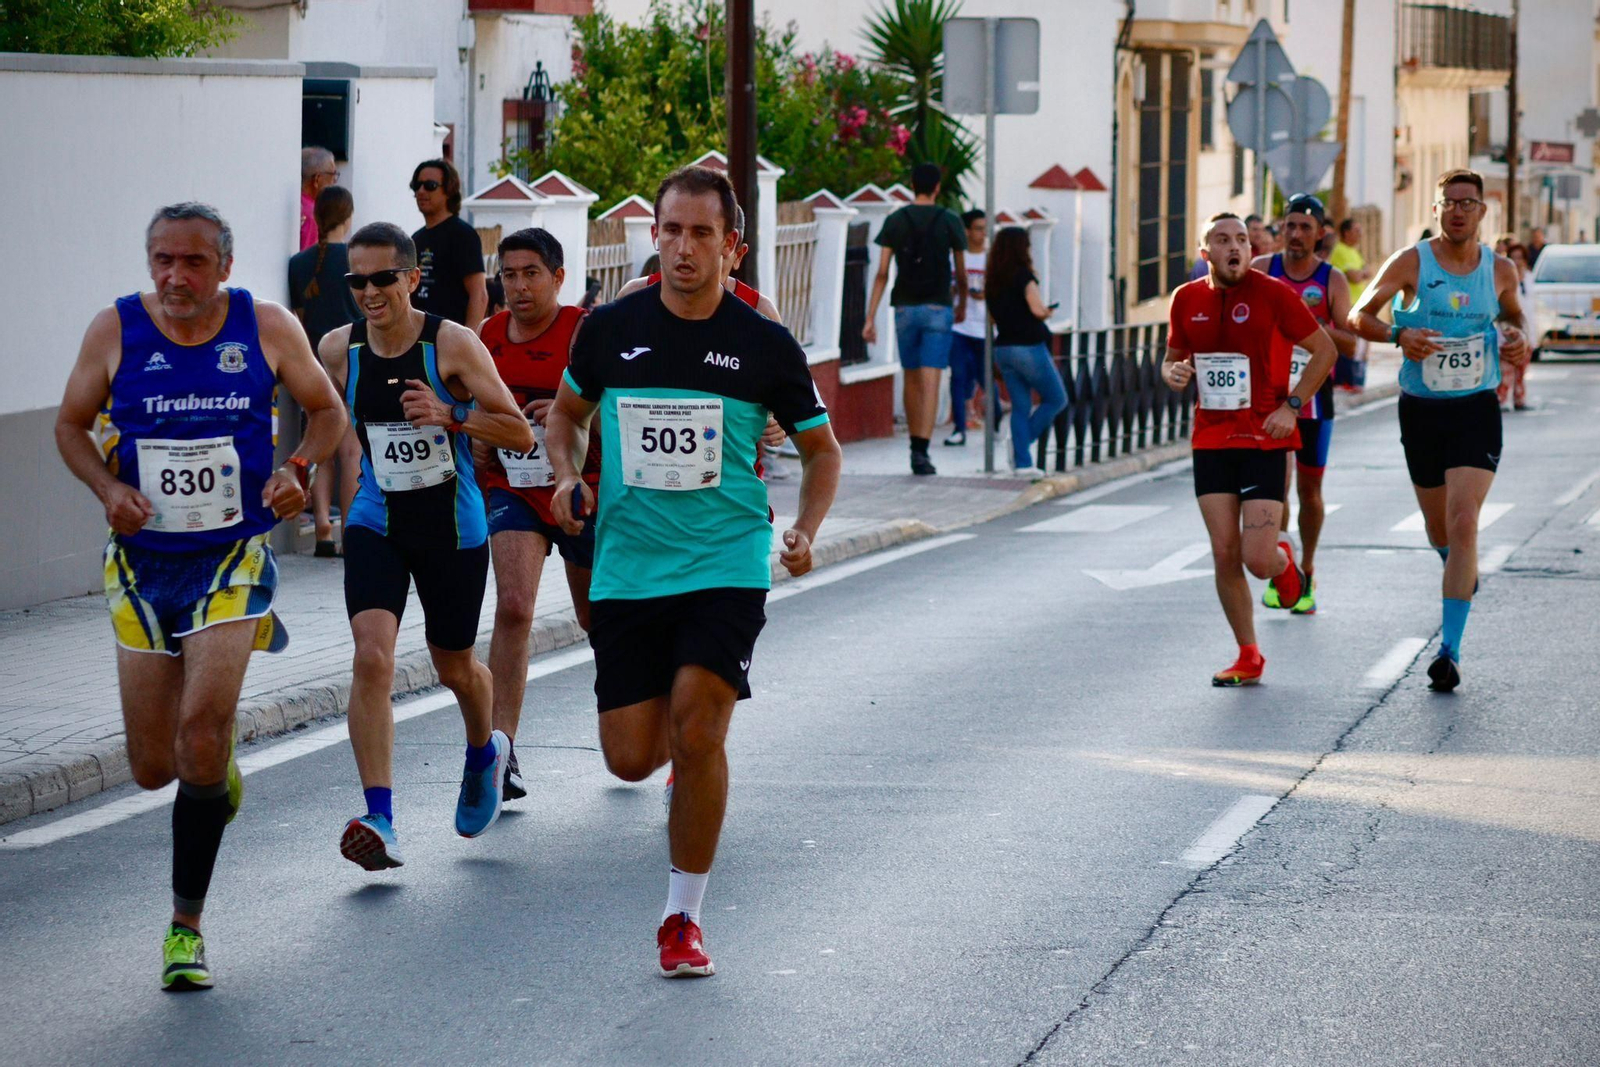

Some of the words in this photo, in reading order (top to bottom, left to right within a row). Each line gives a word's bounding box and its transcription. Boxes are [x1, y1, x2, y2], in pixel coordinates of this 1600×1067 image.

[704, 351, 740, 370] AMG
[1436, 352, 1472, 370] 763
[1206, 370, 1236, 387] 386
[142, 391, 250, 413] Tirabuzón
[384, 439, 431, 463] 499
[641, 427, 697, 454] 503
[161, 467, 215, 496] 830
